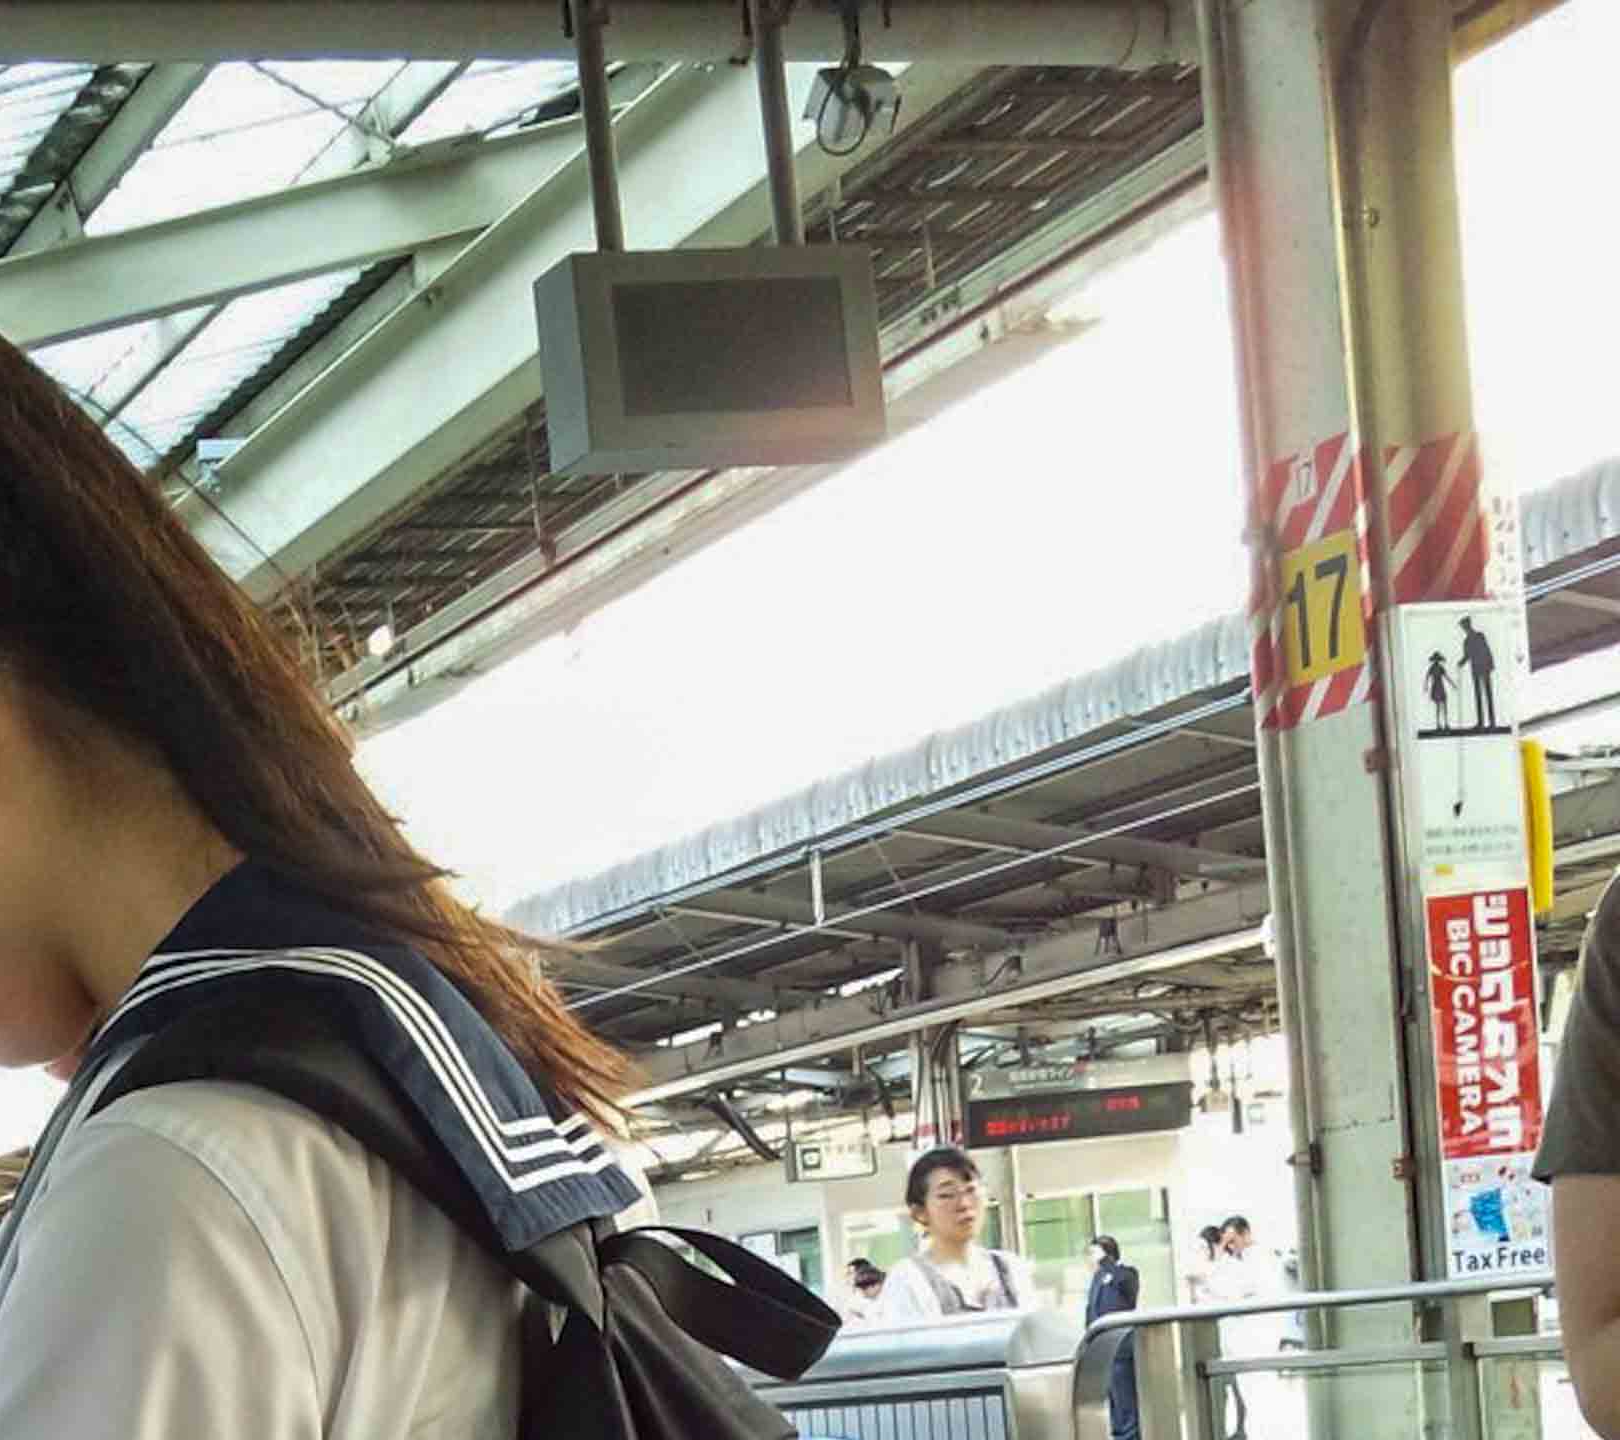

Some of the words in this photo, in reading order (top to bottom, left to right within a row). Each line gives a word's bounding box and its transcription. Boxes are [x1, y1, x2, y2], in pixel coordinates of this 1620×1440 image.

[1287, 554, 1348, 668] 17
[1445, 918, 1473, 977] BIC
[1452, 984, 1483, 1136] CAMERA
[1452, 1249, 1492, 1273] Tax
[1497, 1246, 1546, 1268] Free
